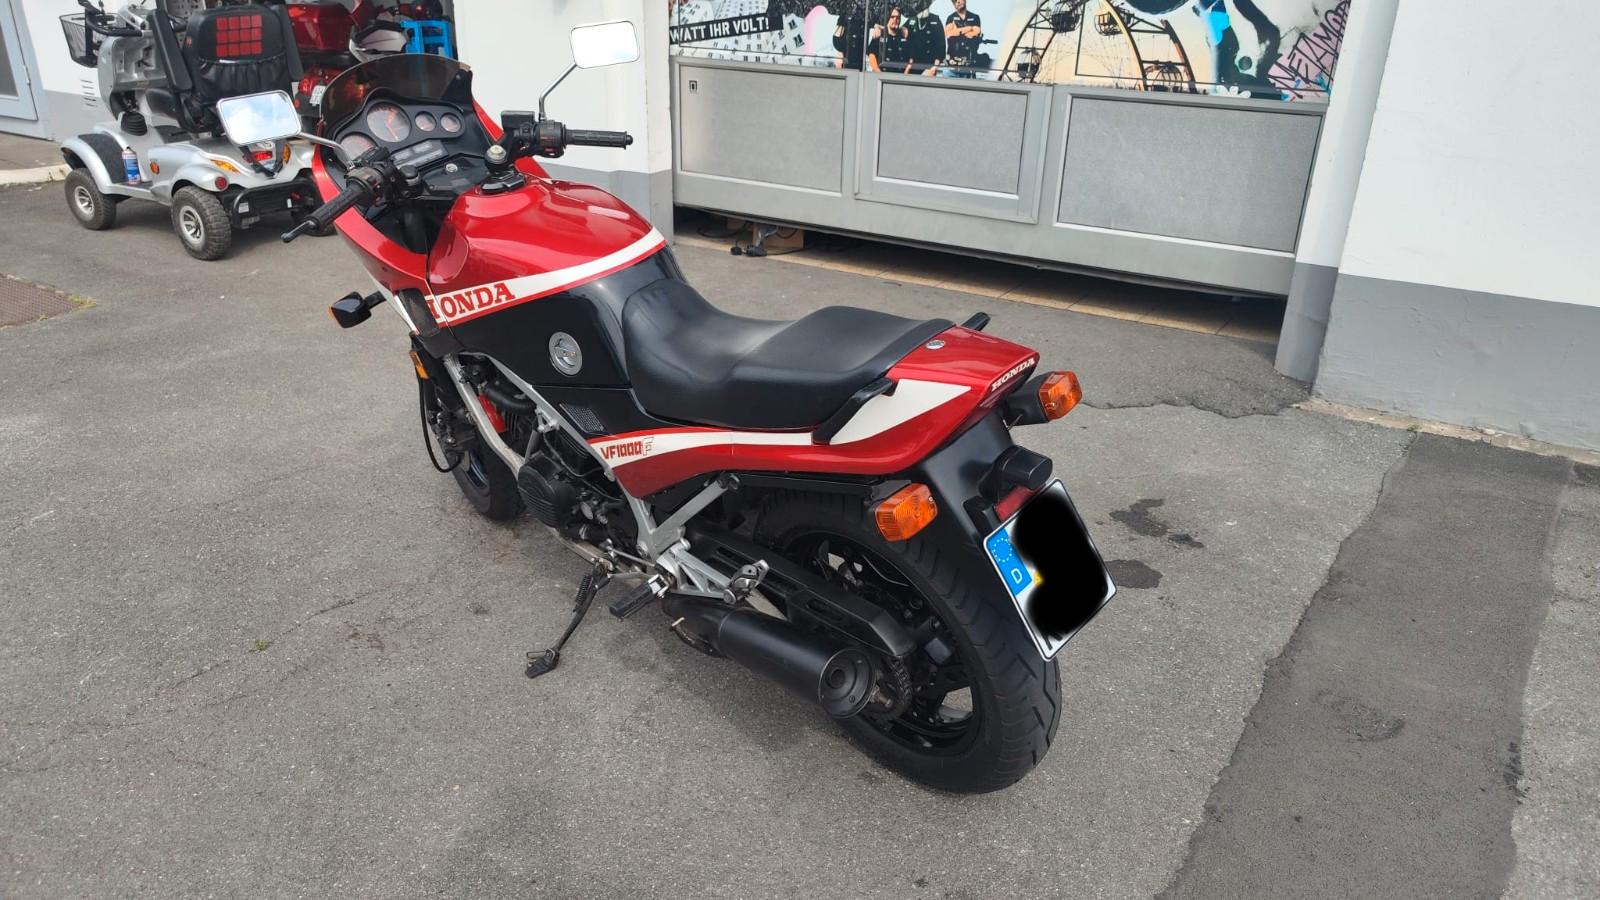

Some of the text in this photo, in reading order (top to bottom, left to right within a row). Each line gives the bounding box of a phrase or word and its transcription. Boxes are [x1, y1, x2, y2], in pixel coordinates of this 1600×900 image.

[669, 16, 770, 43] WATT IHR VOLT!
[991, 357, 1035, 391] HONDA
[1011, 568, 1022, 584] D
